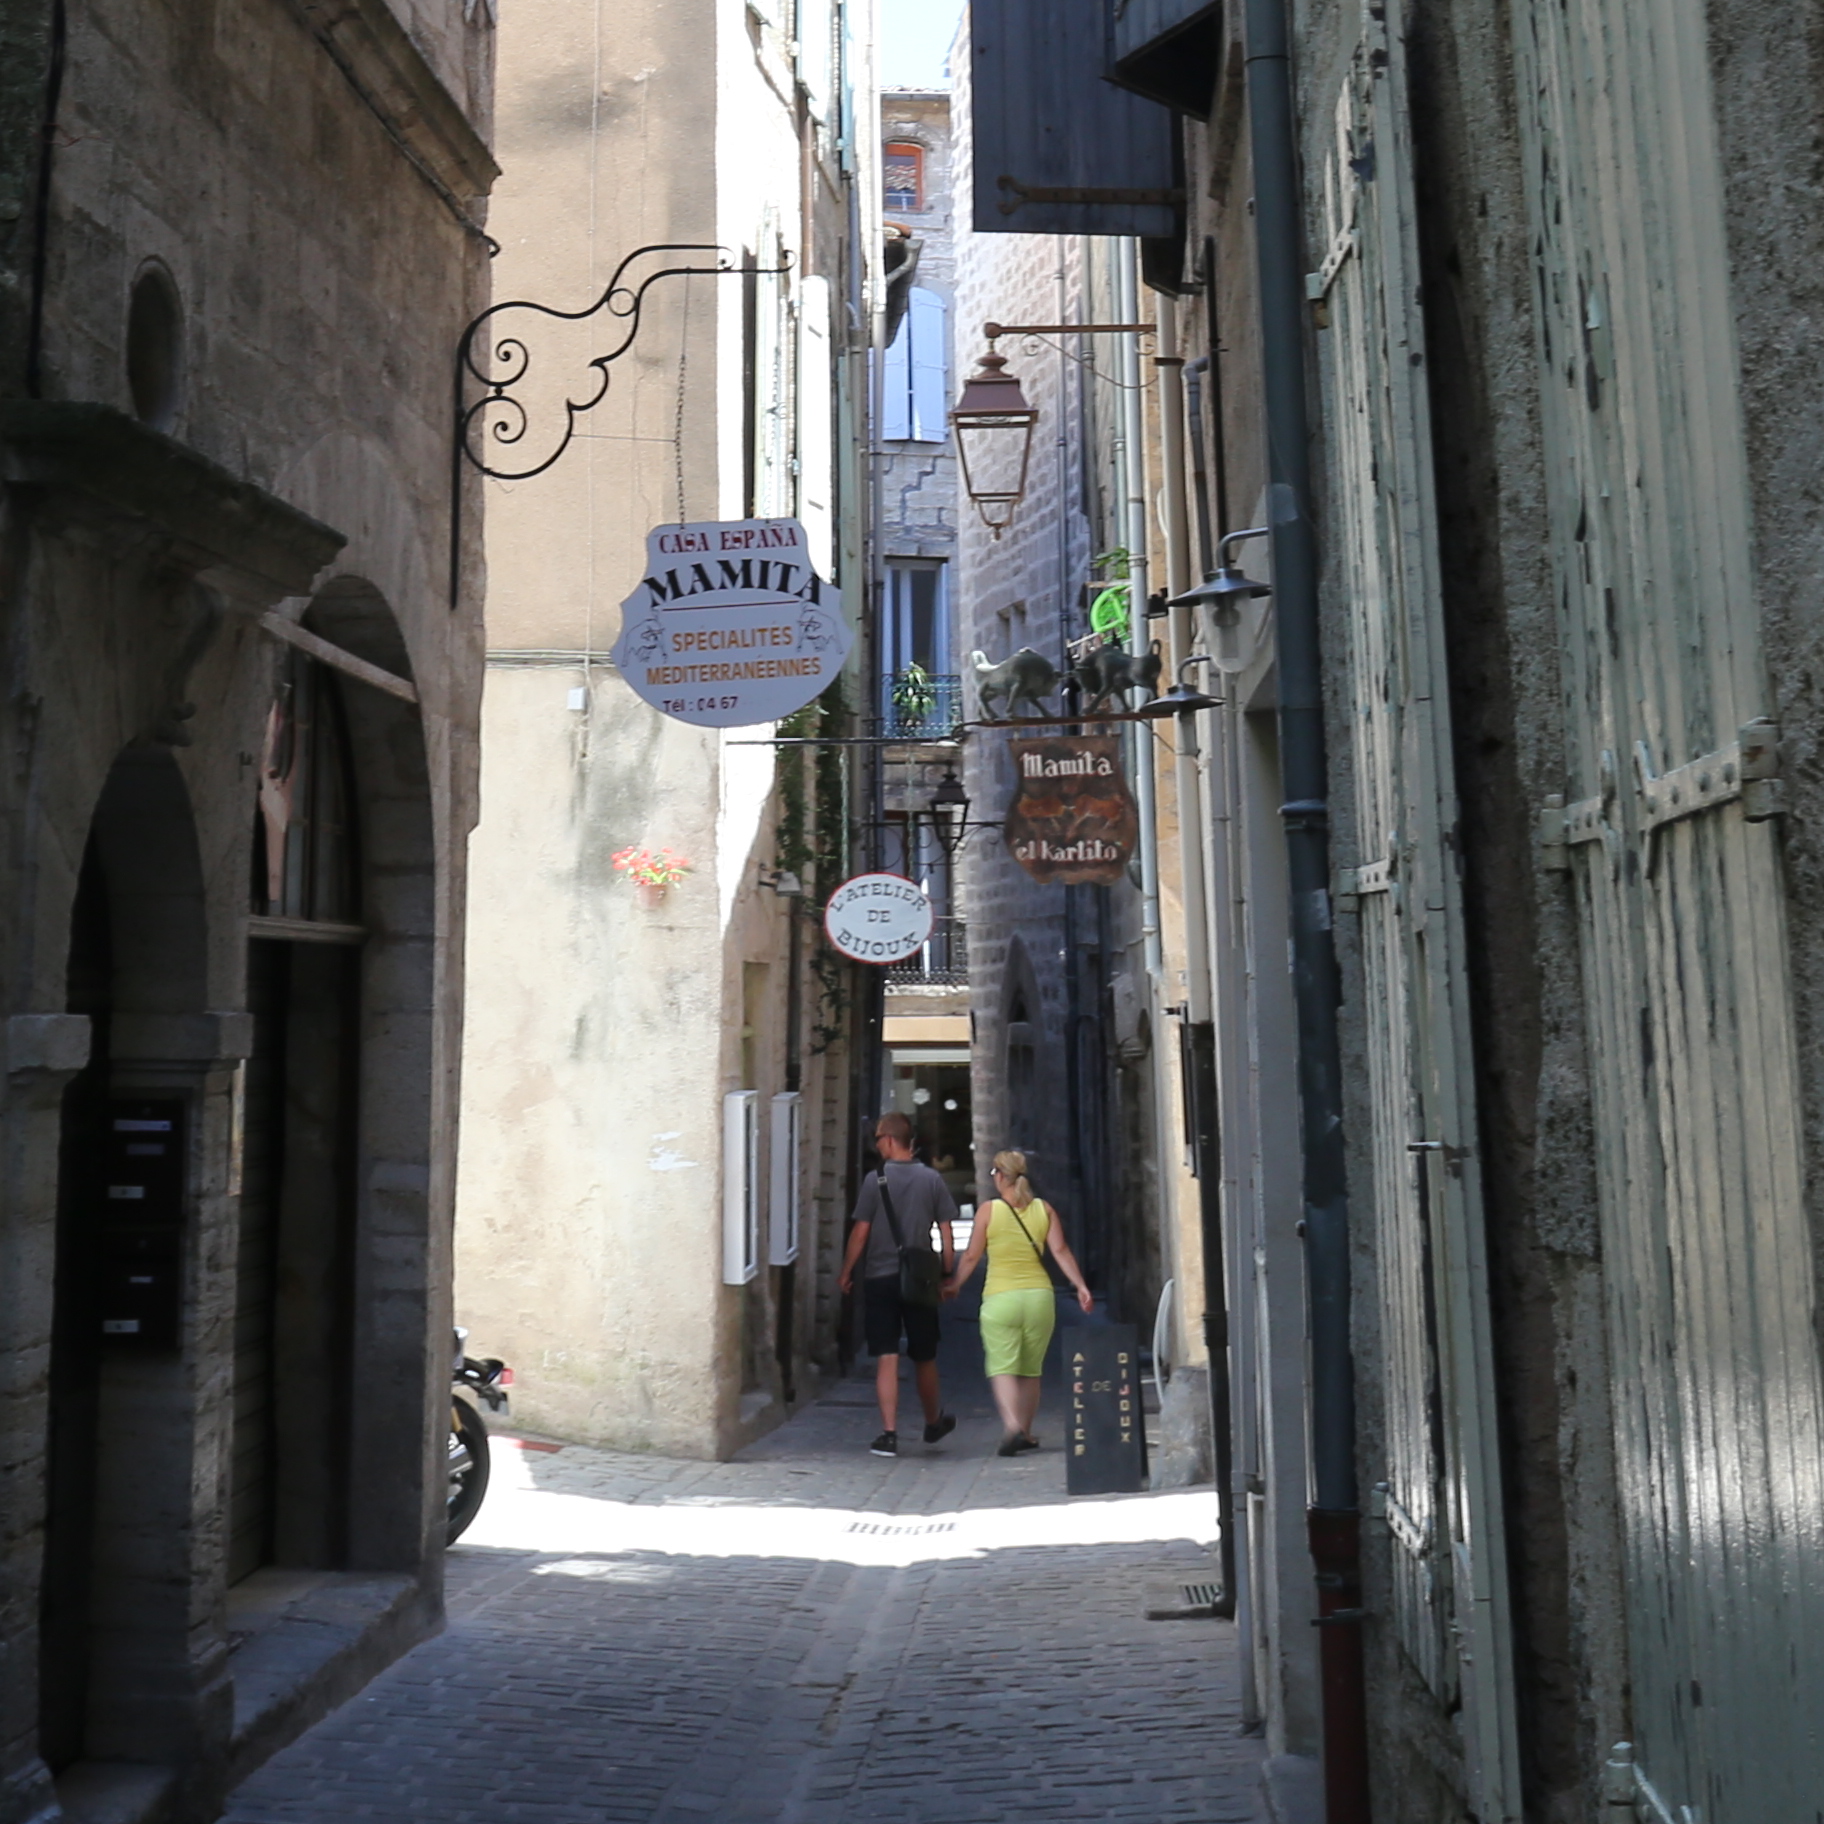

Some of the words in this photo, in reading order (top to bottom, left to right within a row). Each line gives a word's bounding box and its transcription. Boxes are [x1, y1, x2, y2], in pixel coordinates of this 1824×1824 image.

[658, 531, 710, 554] CASA
[719, 523, 799, 552] ESPAÑA
[642, 558, 821, 608] MAMITA
[671, 620, 794, 652] SPÉCIALITÉS
[720, 695, 738, 710] 67
[1019, 751, 1114, 778] Mamita
[829, 882, 927, 913] L'ATELIER
[867, 909, 891, 923] DE
[836, 928, 919, 956] BIJOUX
[1091, 1380, 1112, 1392] DE
